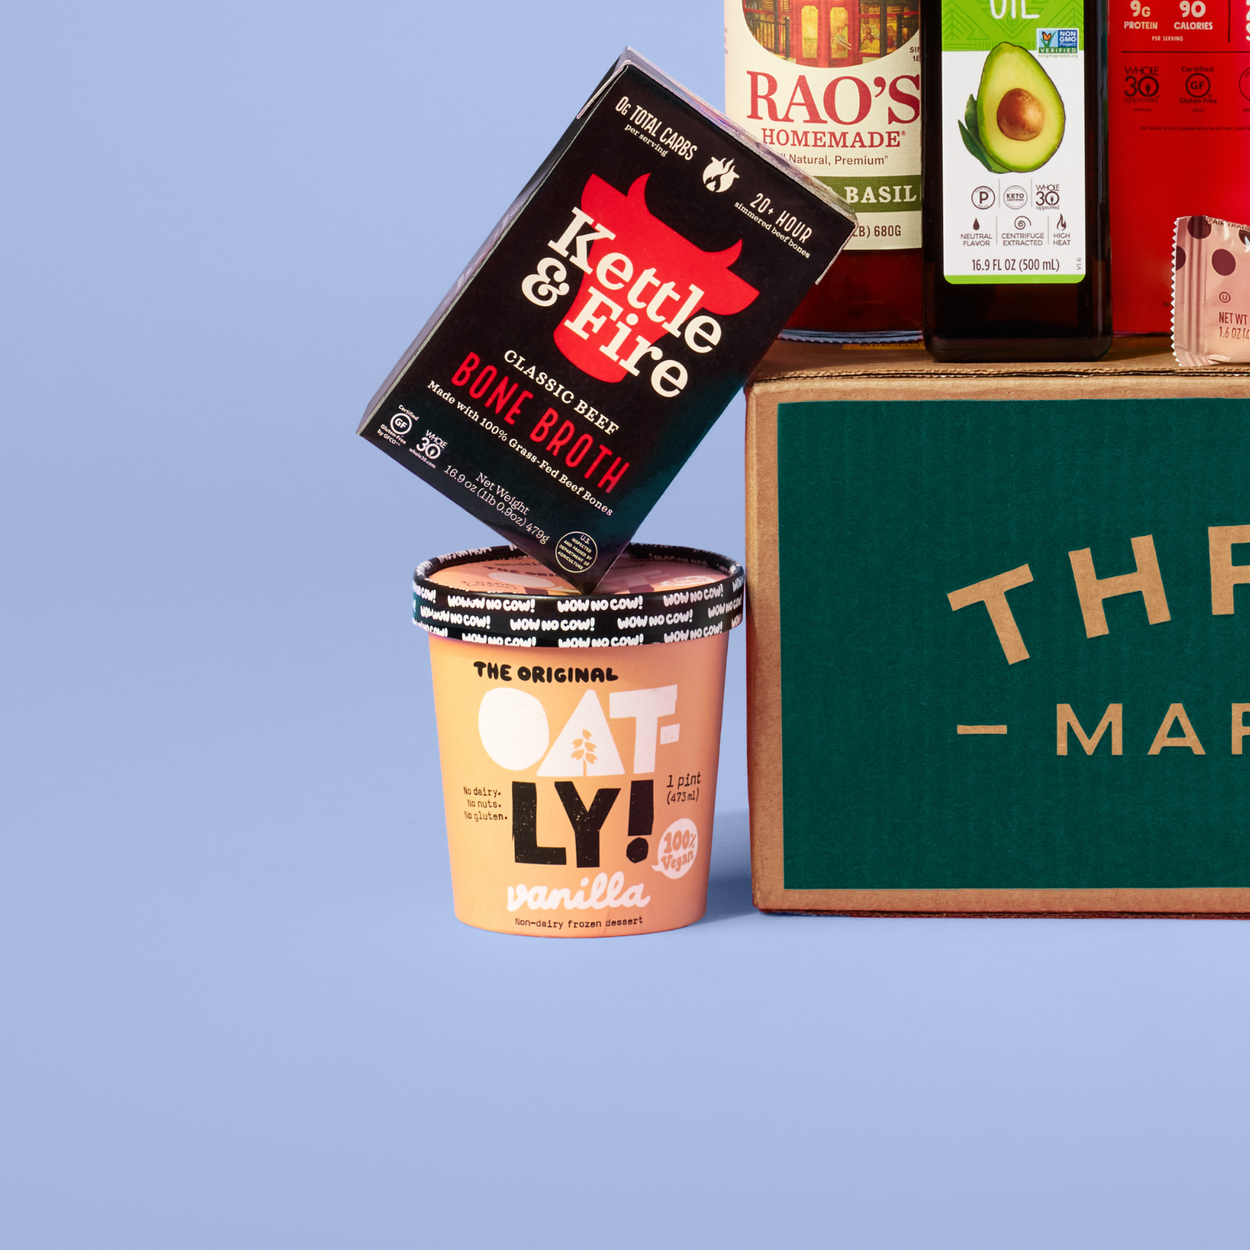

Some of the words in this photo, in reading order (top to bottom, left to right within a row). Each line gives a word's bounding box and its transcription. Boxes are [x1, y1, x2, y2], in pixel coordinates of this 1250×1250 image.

[1179, 1, 1207, 18] 90
[1124, 21, 1158, 30] PROTEIN
[1174, 21, 1214, 30] CALORIES
[747, 71, 921, 126] RAO'S
[629, 105, 663, 138] TOTAL
[660, 127, 698, 161] CARBS
[761, 128, 901, 148] HOMEMADE
[845, 186, 917, 203] BASIL
[750, 193, 775, 215] 20+
[776, 211, 813, 244] HOUR
[874, 225, 902, 237] 680G
[972, 259, 990, 271] 16.9
[993, 259, 1002, 271] FL
[1005, 259, 1016, 271] OZ
[1019, 259, 1040, 272] (500
[1043, 259, 1060, 272] mL)
[548, 207, 722, 354] Kettle
[522, 257, 570, 307] &
[564, 286, 688, 398] Fire
[504, 350, 575, 404] CLASSIC
[574, 400, 620, 436] BEEF
[451, 351, 534, 426] BONE
[530, 408, 630, 494] BROTH
[427, 380, 456, 406] Made
[456, 401, 481, 422] with
[479, 417, 508, 442] 100%
[509, 439, 558, 480] Grass-Fed
[558, 474, 585, 496] Beef
[582, 490, 614, 517] Bones
[557, 600, 590, 613] WOW
[591, 600, 609, 611] NO
[610, 596, 644, 611] COW!
[473, 661, 512, 681] THE
[517, 665, 619, 683] ORIGINAL
[512, 779, 655, 868] LY!
[663, 829, 697, 854] 100%
[661, 851, 694, 872] Vegan
[508, 871, 651, 912] vanilla
[515, 918, 563, 930] Non-dairy
[568, 919, 602, 928] frozen
[605, 916, 644, 927] dessert
